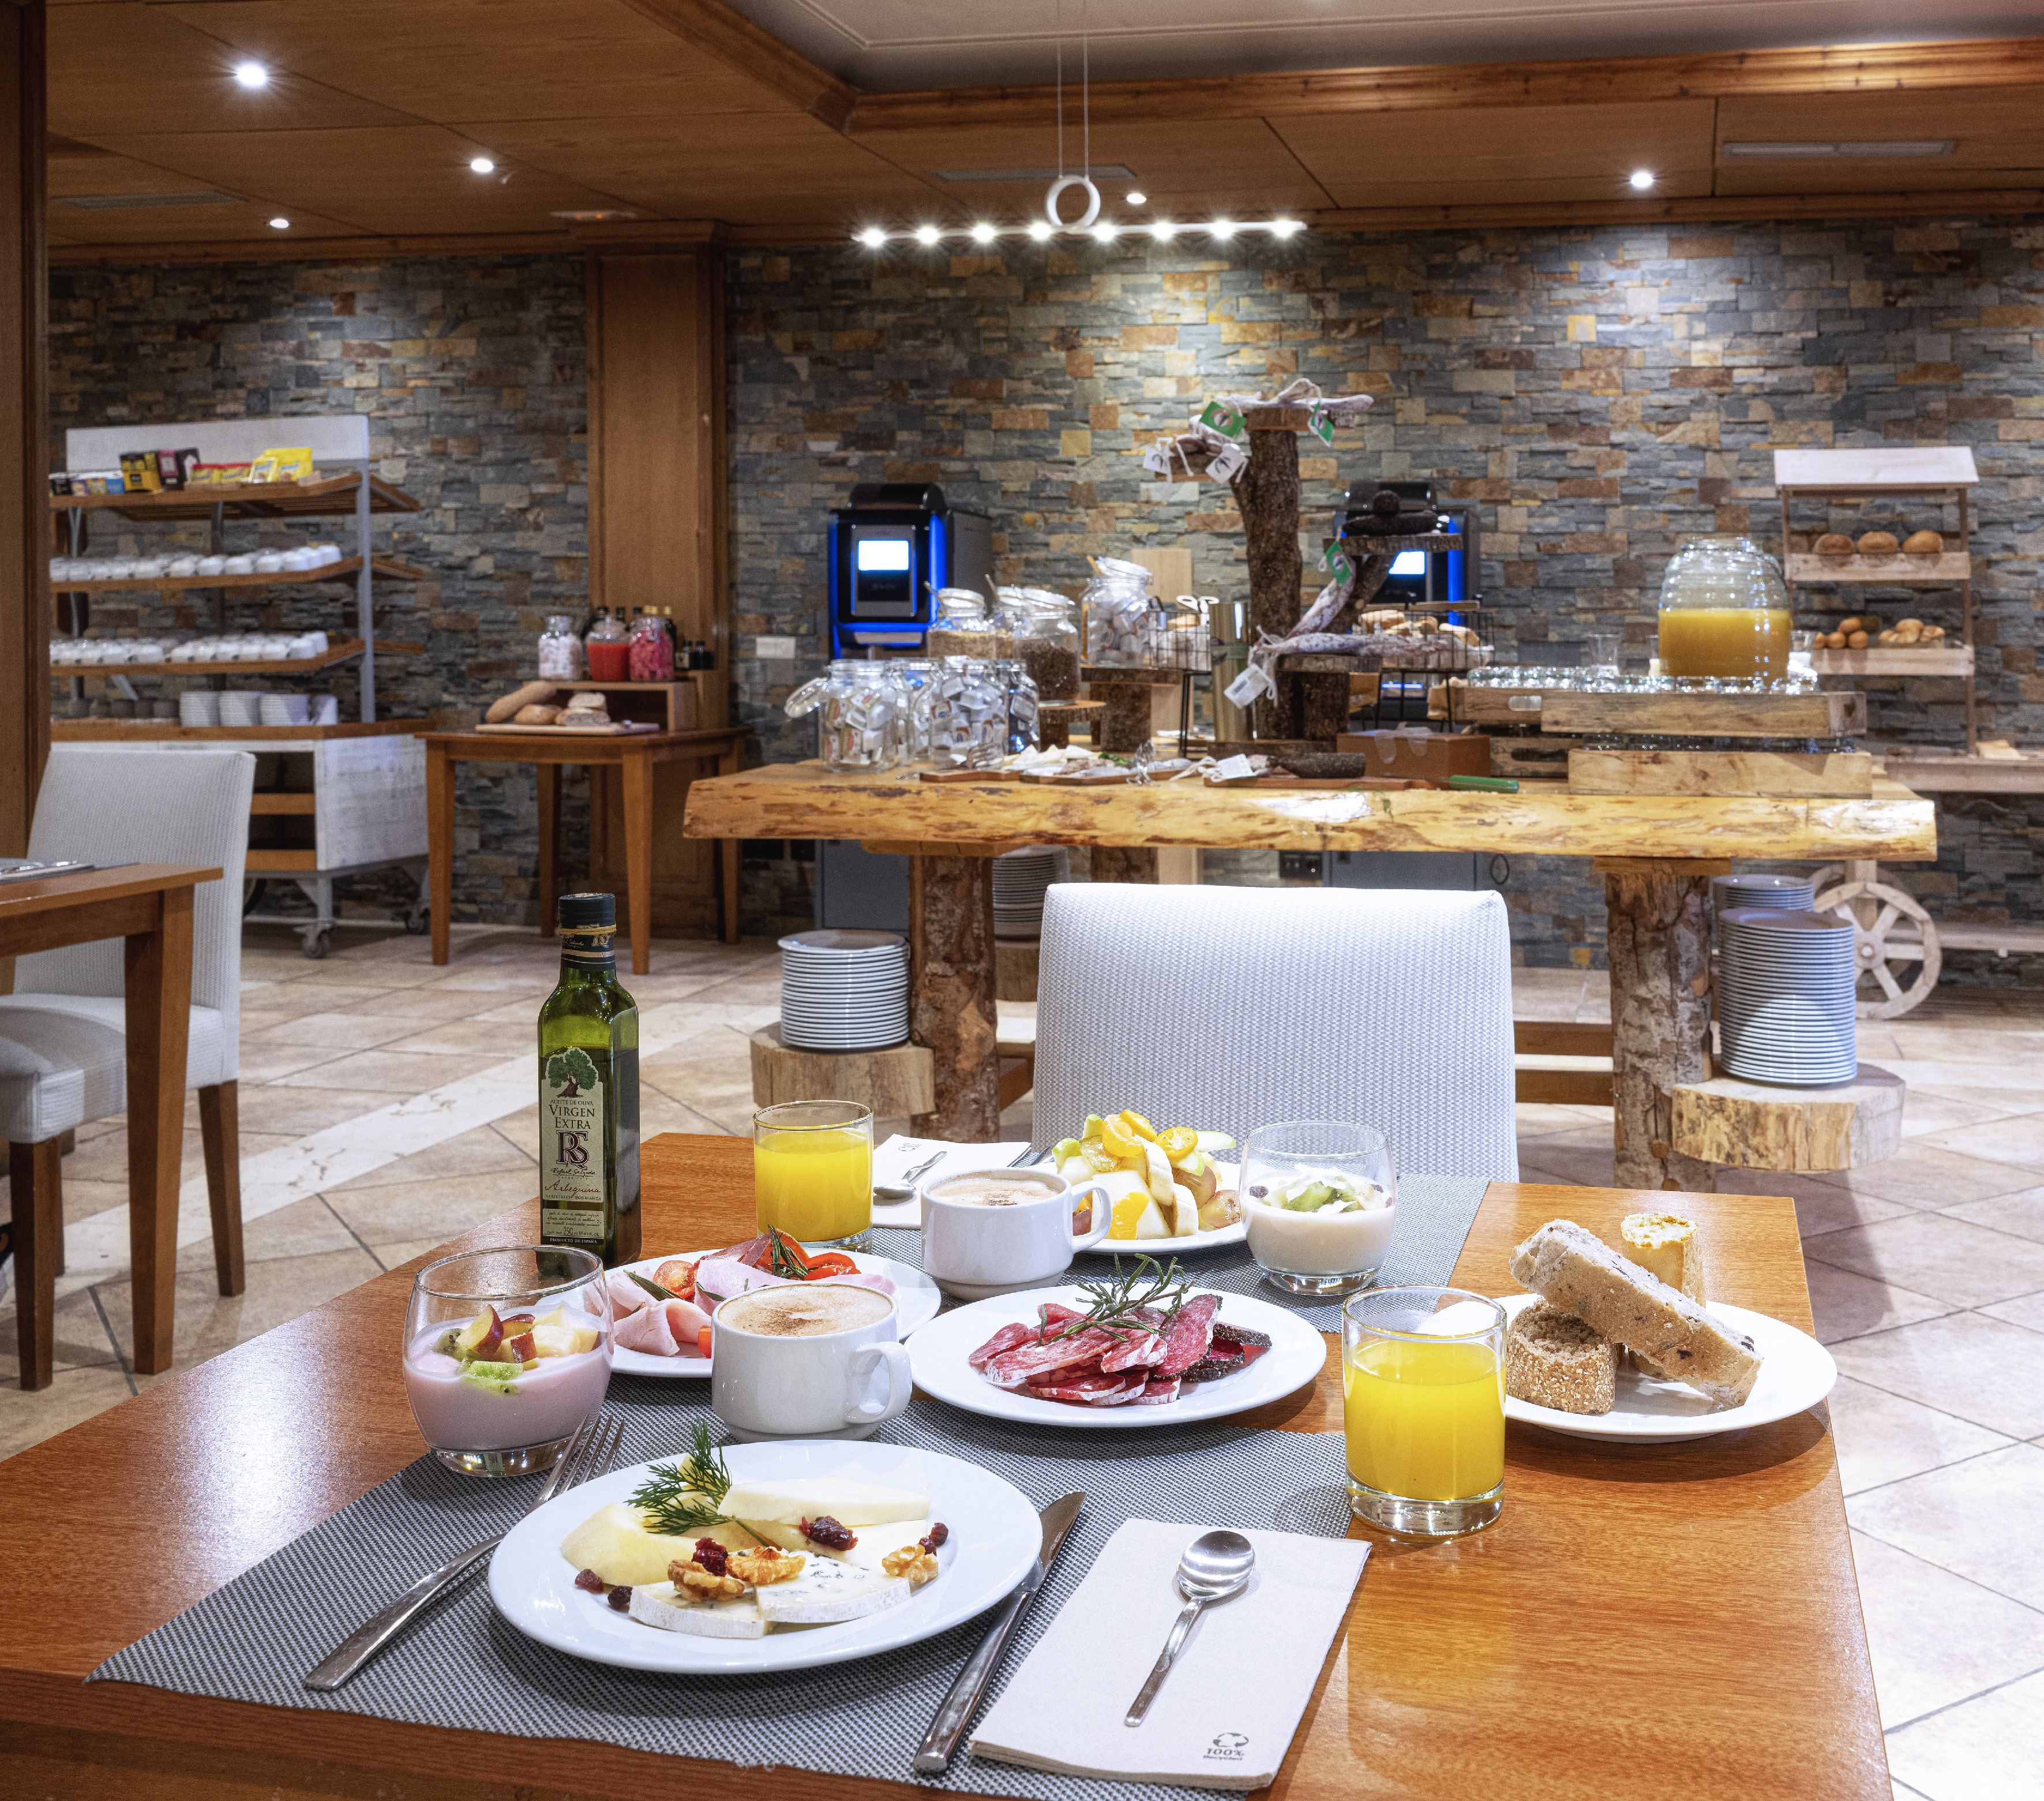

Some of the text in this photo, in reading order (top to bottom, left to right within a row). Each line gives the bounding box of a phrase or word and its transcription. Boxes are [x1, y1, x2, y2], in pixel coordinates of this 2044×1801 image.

[550, 1167, 595, 1178] Rafael Salgado
[545, 1180, 601, 1199] Arbequina
[563, 1226, 573, 1235] 250
[1207, 1748, 1244, 1757] 100%
